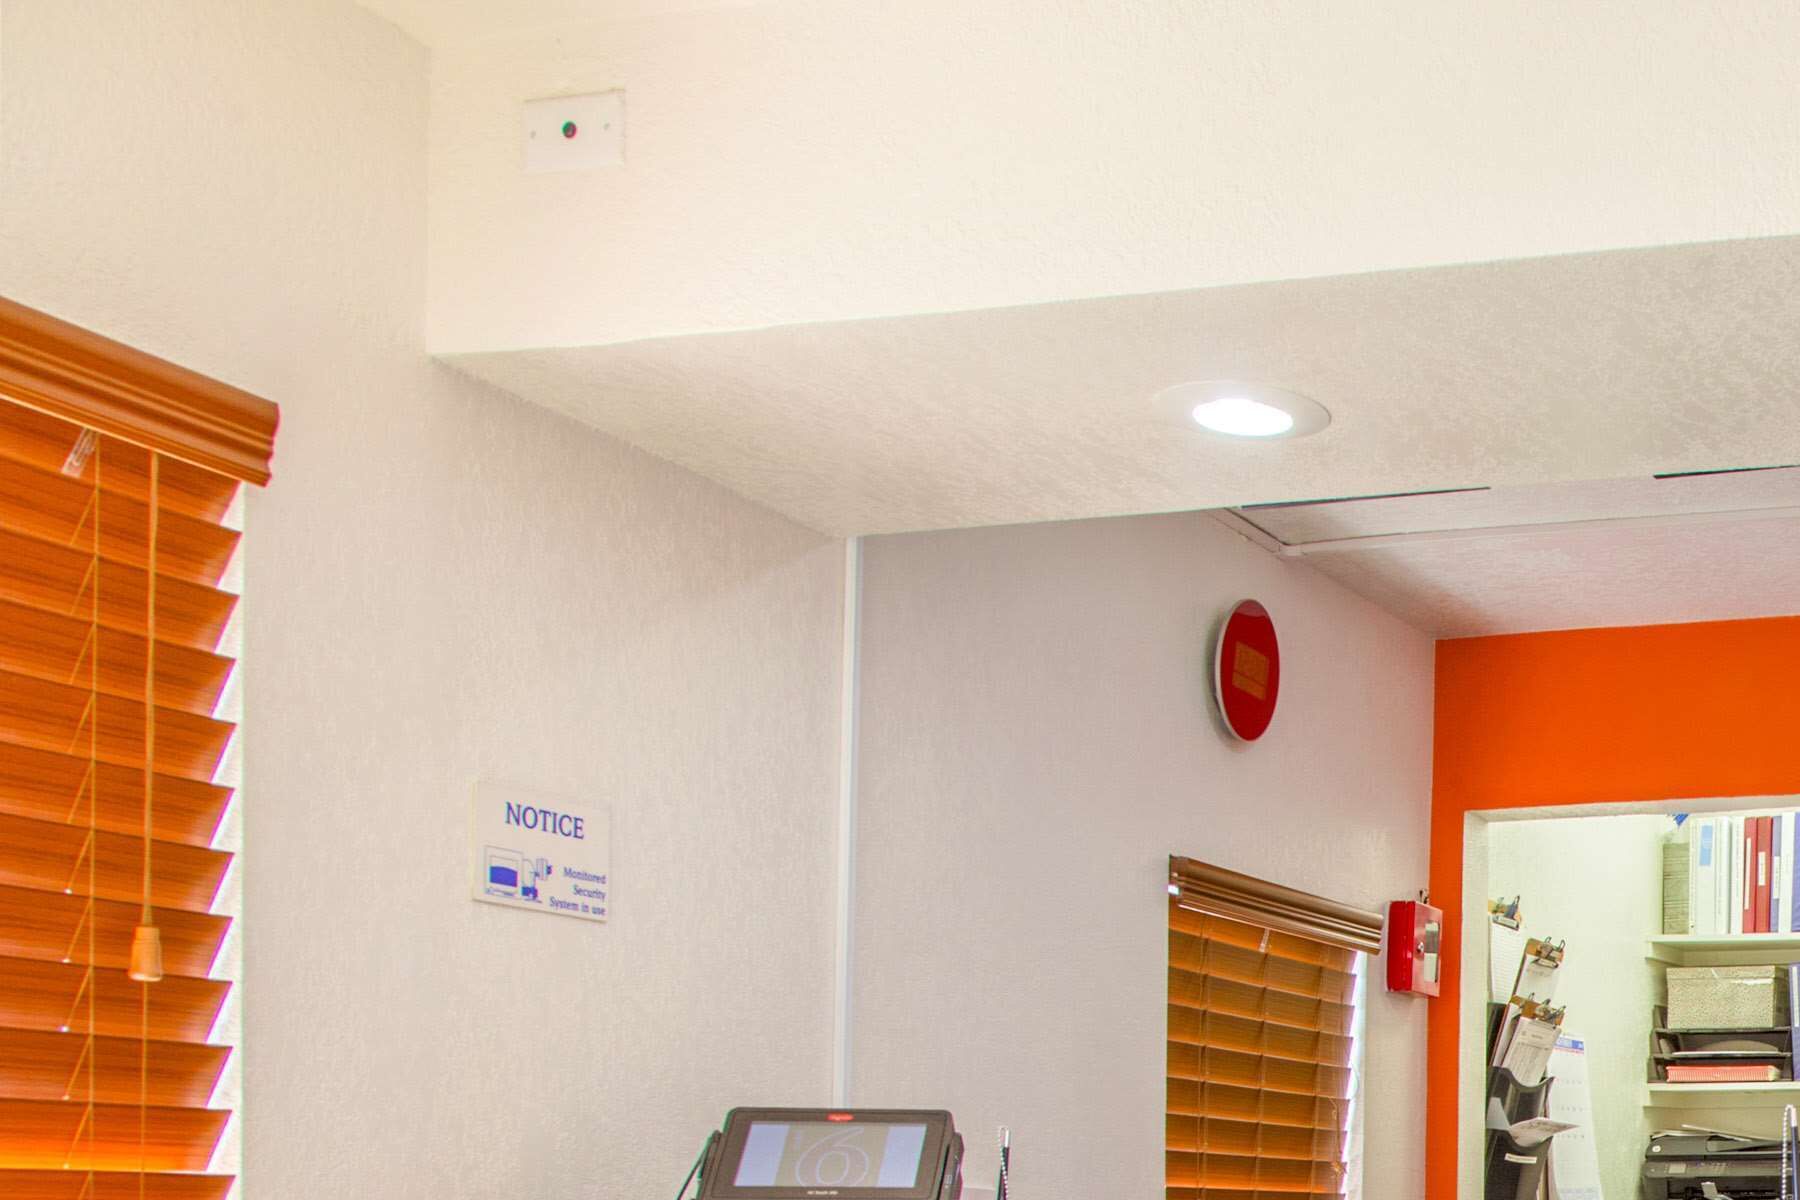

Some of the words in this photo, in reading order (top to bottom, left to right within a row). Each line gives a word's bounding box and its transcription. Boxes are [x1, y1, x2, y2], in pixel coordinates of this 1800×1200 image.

[505, 801, 584, 839] NOTICE
[563, 867, 606, 884] Monitored
[573, 884, 606, 902] Security
[549, 896, 579, 911] System
[581, 903, 589, 912] in
